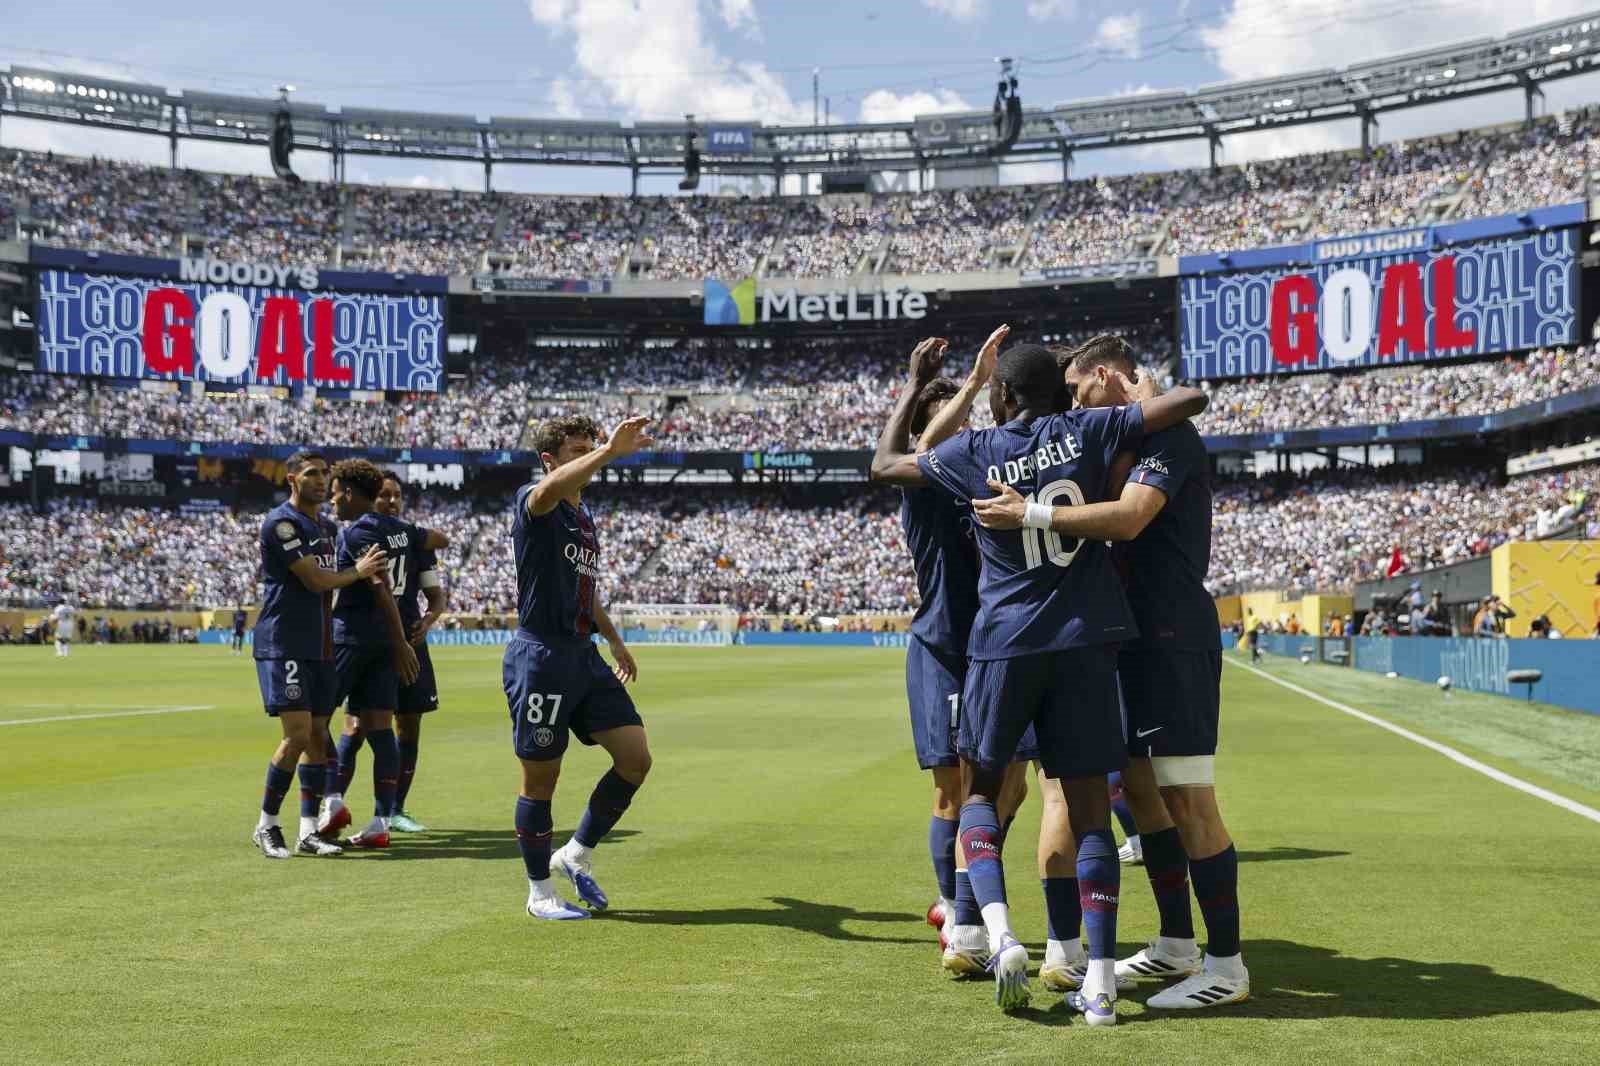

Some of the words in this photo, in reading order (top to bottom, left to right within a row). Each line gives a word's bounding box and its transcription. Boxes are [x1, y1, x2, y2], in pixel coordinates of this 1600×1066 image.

[713, 132, 745, 145] FIFA
[1319, 240, 1361, 259] BUD
[1363, 230, 1425, 253] LIGHT
[179, 258, 319, 290] MOODY'S
[761, 286, 928, 323] MetLife
[1269, 255, 1477, 365] GOAL
[143, 287, 352, 382] GOAL
[763, 453, 813, 467] MetLife
[1022, 479, 1086, 568] 10
[431, 628, 513, 645] visitQATA
[285, 660, 299, 685] 2
[526, 692, 563, 726] 87
